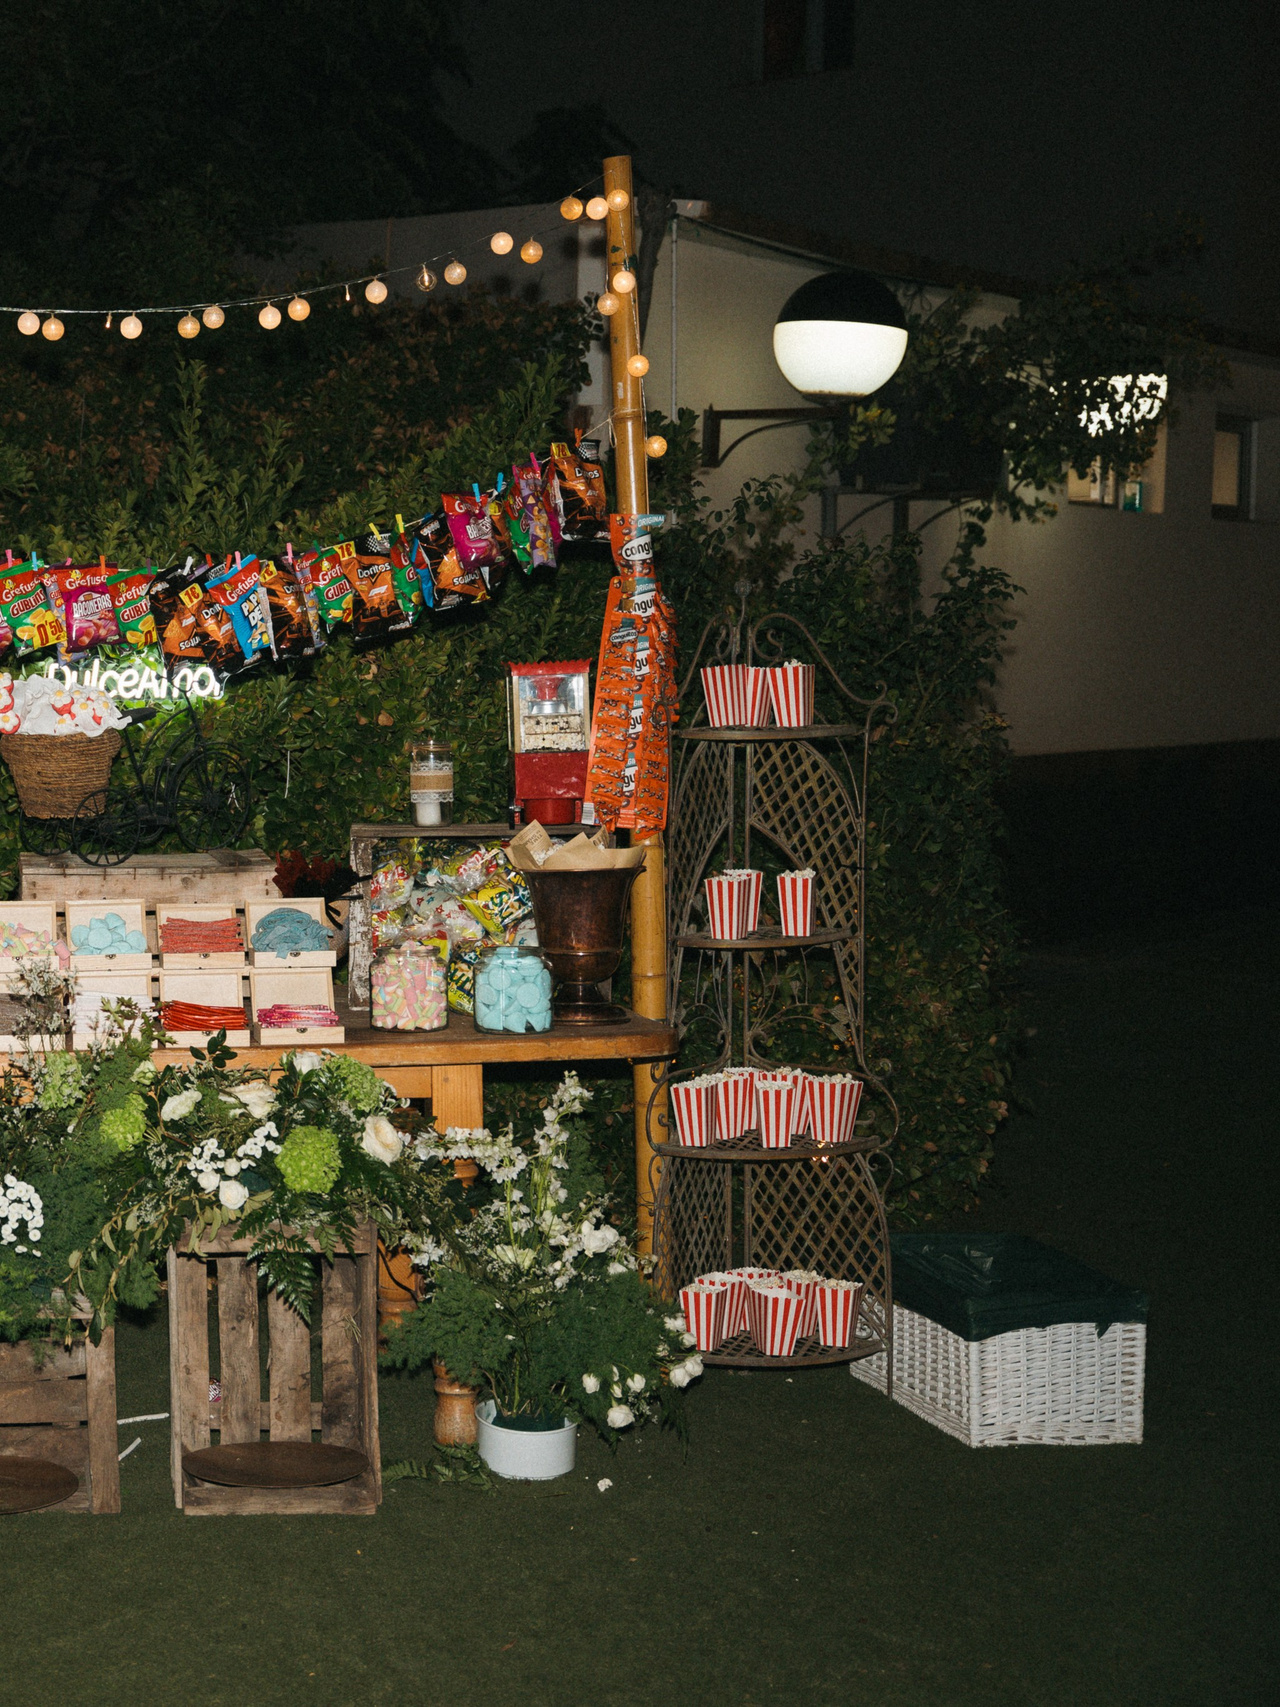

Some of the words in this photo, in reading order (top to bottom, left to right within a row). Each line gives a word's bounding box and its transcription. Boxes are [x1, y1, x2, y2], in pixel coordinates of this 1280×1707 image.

[338, 543, 353, 558] 1€
[357, 561, 391, 579] Doritos
[65, 573, 108, 590] Grefusa
[226, 571, 260, 602] Grefusa
[324, 579, 351, 601] GUBL
[184, 586, 201, 605] 1€
[121, 600, 149, 622] GUBLI
